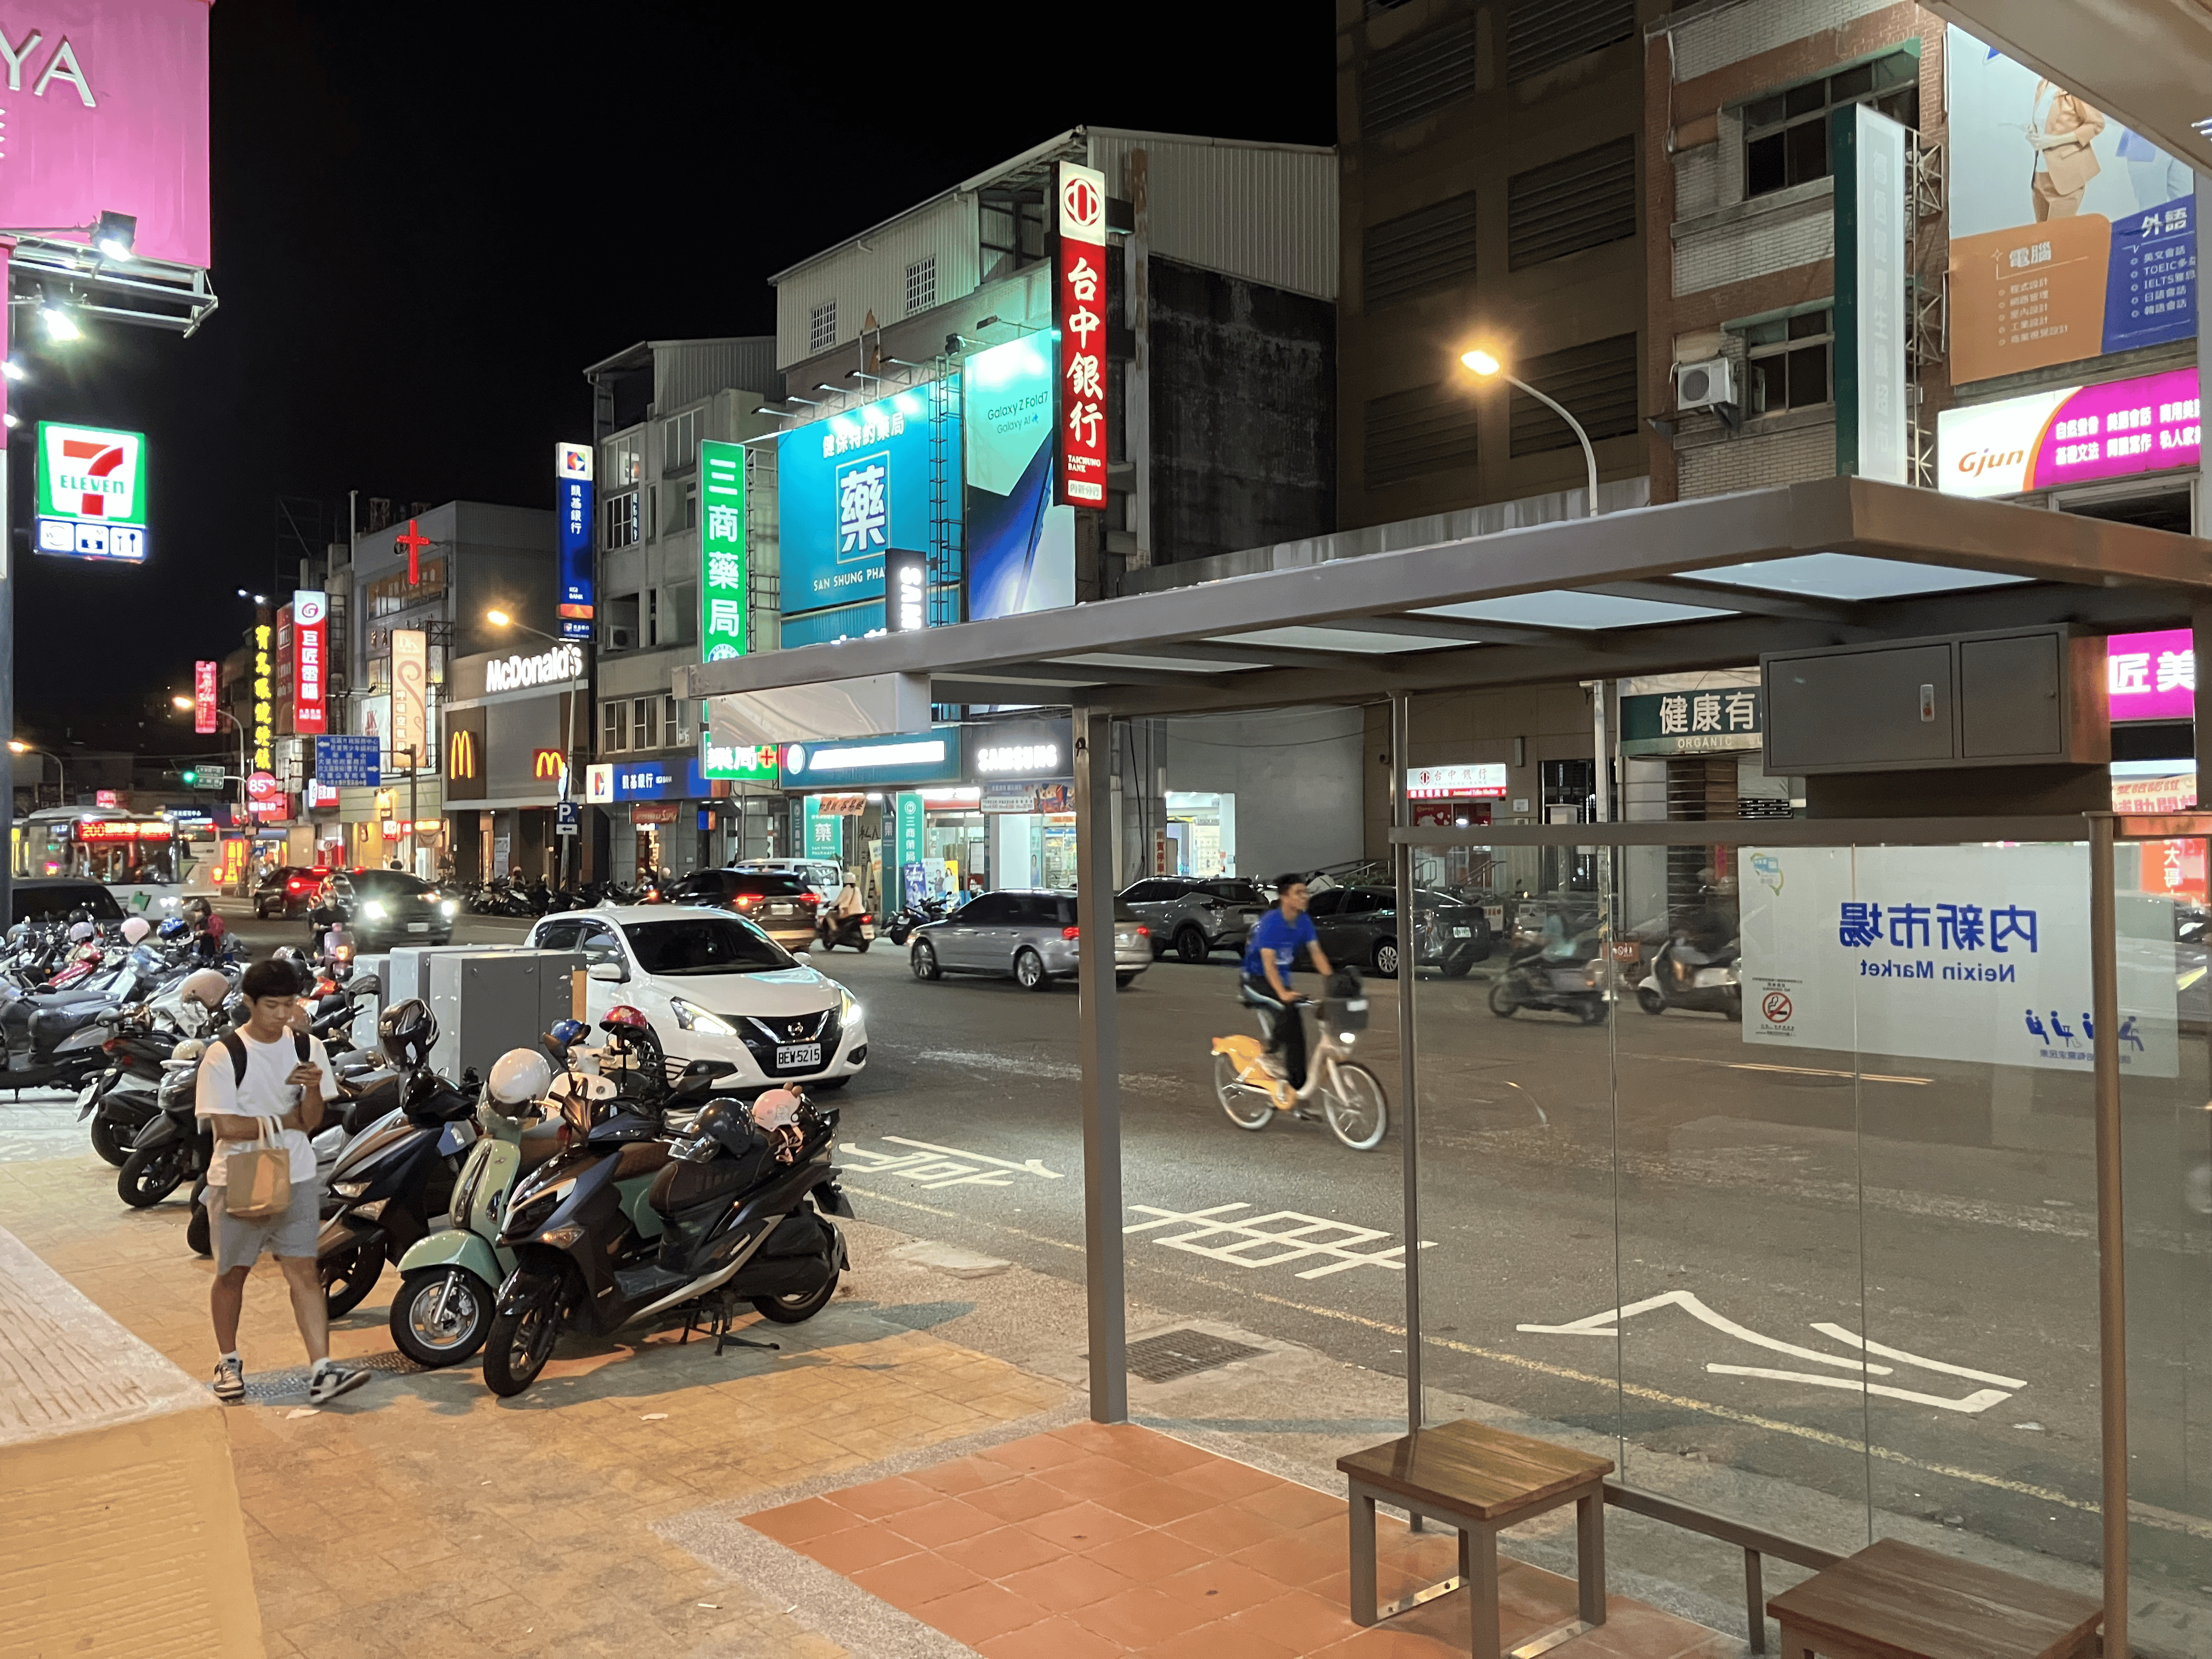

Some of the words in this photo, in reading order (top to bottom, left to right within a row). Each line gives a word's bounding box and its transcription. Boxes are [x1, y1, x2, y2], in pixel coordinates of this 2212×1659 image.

[0, 29, 96, 108] YA
[2142, 207, 2187, 238] 外語
[2009, 241, 2052, 268] 電腦
[1066, 257, 1103, 448] 台中銀行
[988, 401, 1018, 420] Galaxy
[1019, 399, 1025, 411] Z
[1025, 391, 1049, 409] Fold7
[996, 419, 1023, 434] Galaxy
[1068, 454, 1101, 467] TAICHUNG
[1068, 462, 1086, 473] BANK
[1958, 447, 2024, 478] Gjun
[840, 464, 887, 553] 藥
[708, 458, 740, 638] 三商藥局
[814, 578, 831, 592] SAN
[833, 572, 863, 589] SHUNG
[866, 565, 885, 580] PHA
[486, 643, 583, 692] McDonald's
[1659, 691, 1756, 735] 健康有
[1678, 736, 1733, 749] ORGANIC
[978, 744, 1057, 772] SAMSUNG
[1434, 768, 1487, 781] 台中銀行
[777, 1047, 821, 1065] BEW-5215
